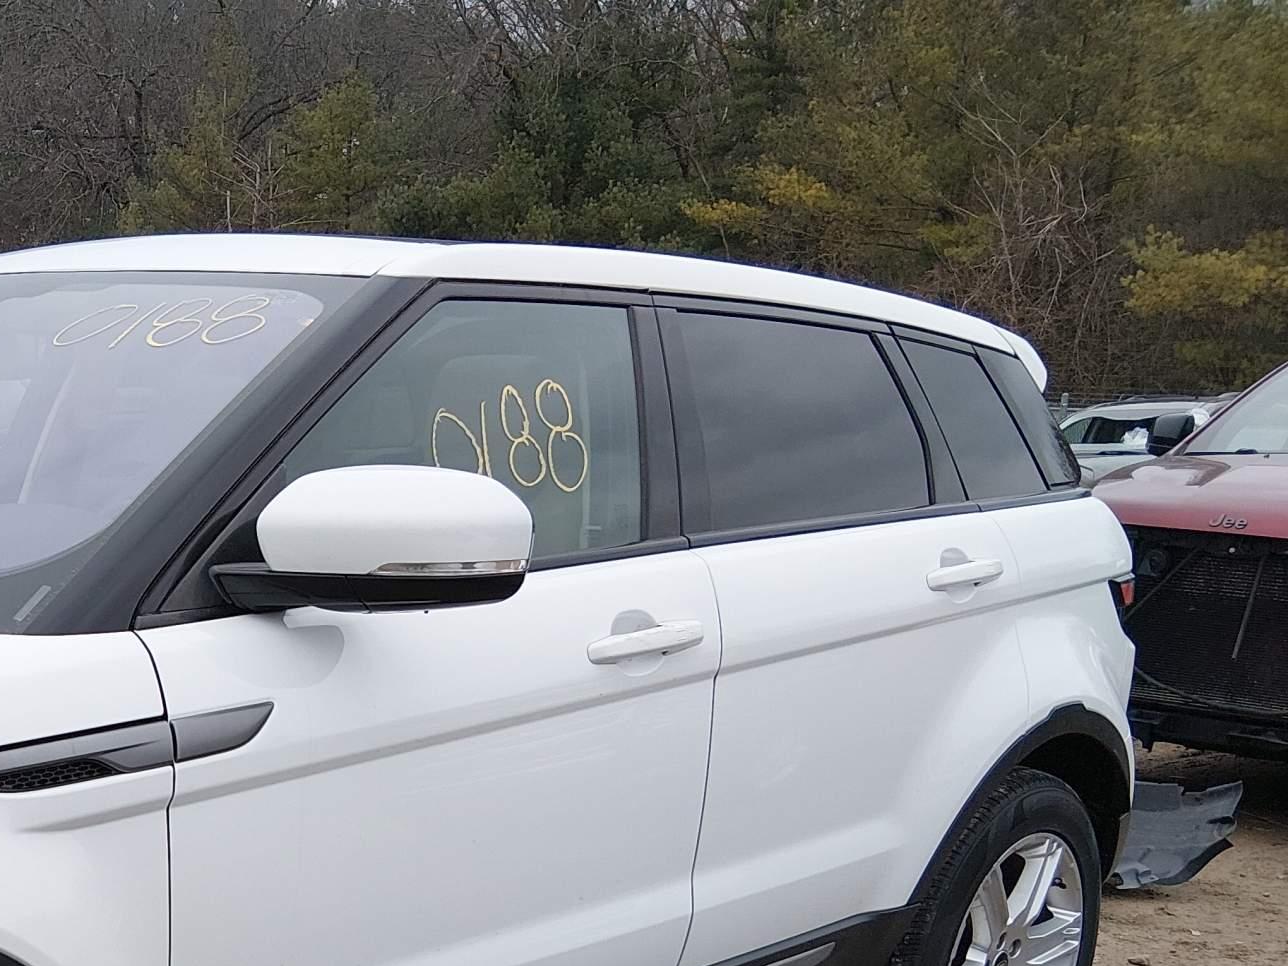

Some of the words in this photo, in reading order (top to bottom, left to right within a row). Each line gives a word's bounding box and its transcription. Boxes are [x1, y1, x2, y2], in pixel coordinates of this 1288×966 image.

[52, 294, 270, 349] 0188
[431, 378, 589, 493] 0188
[1208, 513, 1249, 530] Jee
